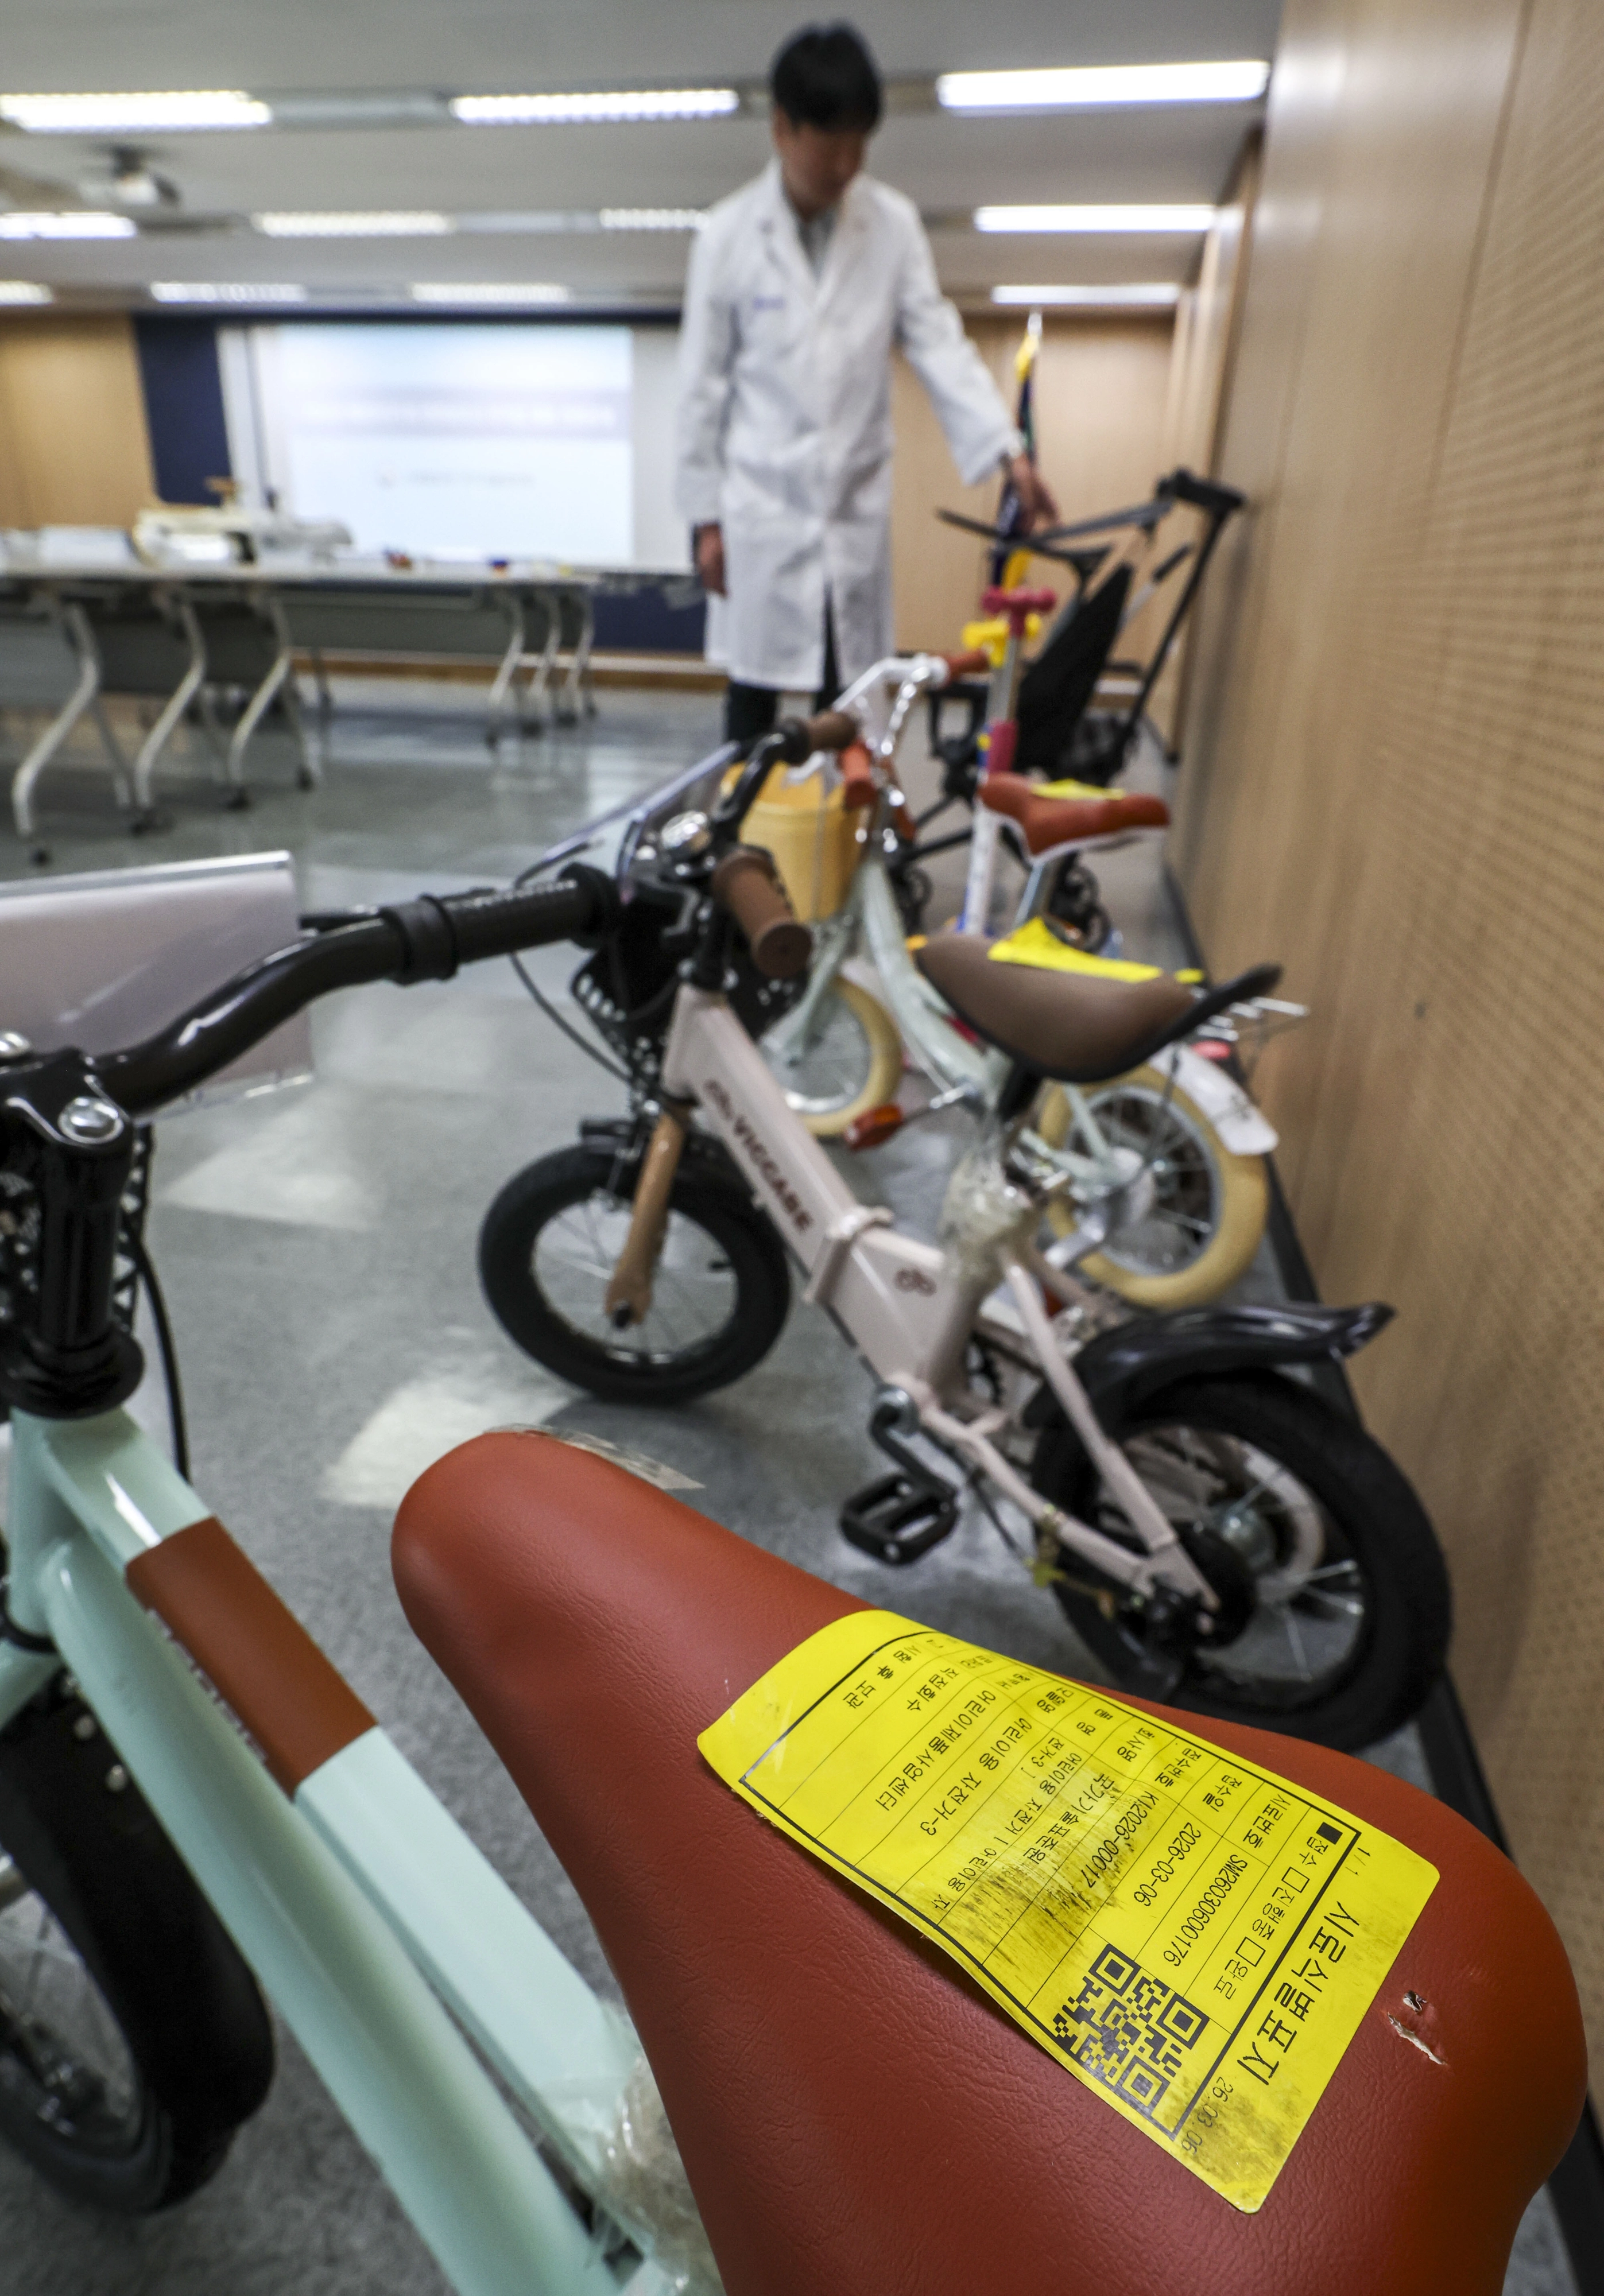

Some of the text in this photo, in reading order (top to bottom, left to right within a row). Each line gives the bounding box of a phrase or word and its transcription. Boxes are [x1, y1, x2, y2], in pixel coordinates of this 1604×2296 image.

[843, 1645, 921, 1709] 시험 후 보관
[906, 1667, 959, 1711] 직접회수
[1037, 1688, 1073, 1713] 모델명
[875, 1690, 995, 1810] 어린이제품사업센터
[1032, 1737, 1064, 1767] 전거-3
[1117, 1728, 1154, 1762] 회사명
[1155, 1748, 1201, 1787] 접수번호
[920, 1718, 1032, 1836] 어린이용 자전거-3
[1040, 1753, 1082, 1794] 어린이용
[1202, 1775, 1242, 1812] 접수일
[1005, 1799, 1042, 1835] 자전거
[1023, 1774, 1114, 1864] 국가기술표준원
[1243, 1794, 1290, 1848] 시료번호
[948, 1848, 997, 1892] 어린이용
[1134, 1822, 1201, 1906] 2026-03-06
[1164, 1855, 1247, 1966] SM26030600176
[1214, 1837, 1328, 2000] 접수 진행중 완료
[1237, 1901, 1359, 2085] 시료식별표지
[1183, 2077, 1233, 2154] 26.03.06
